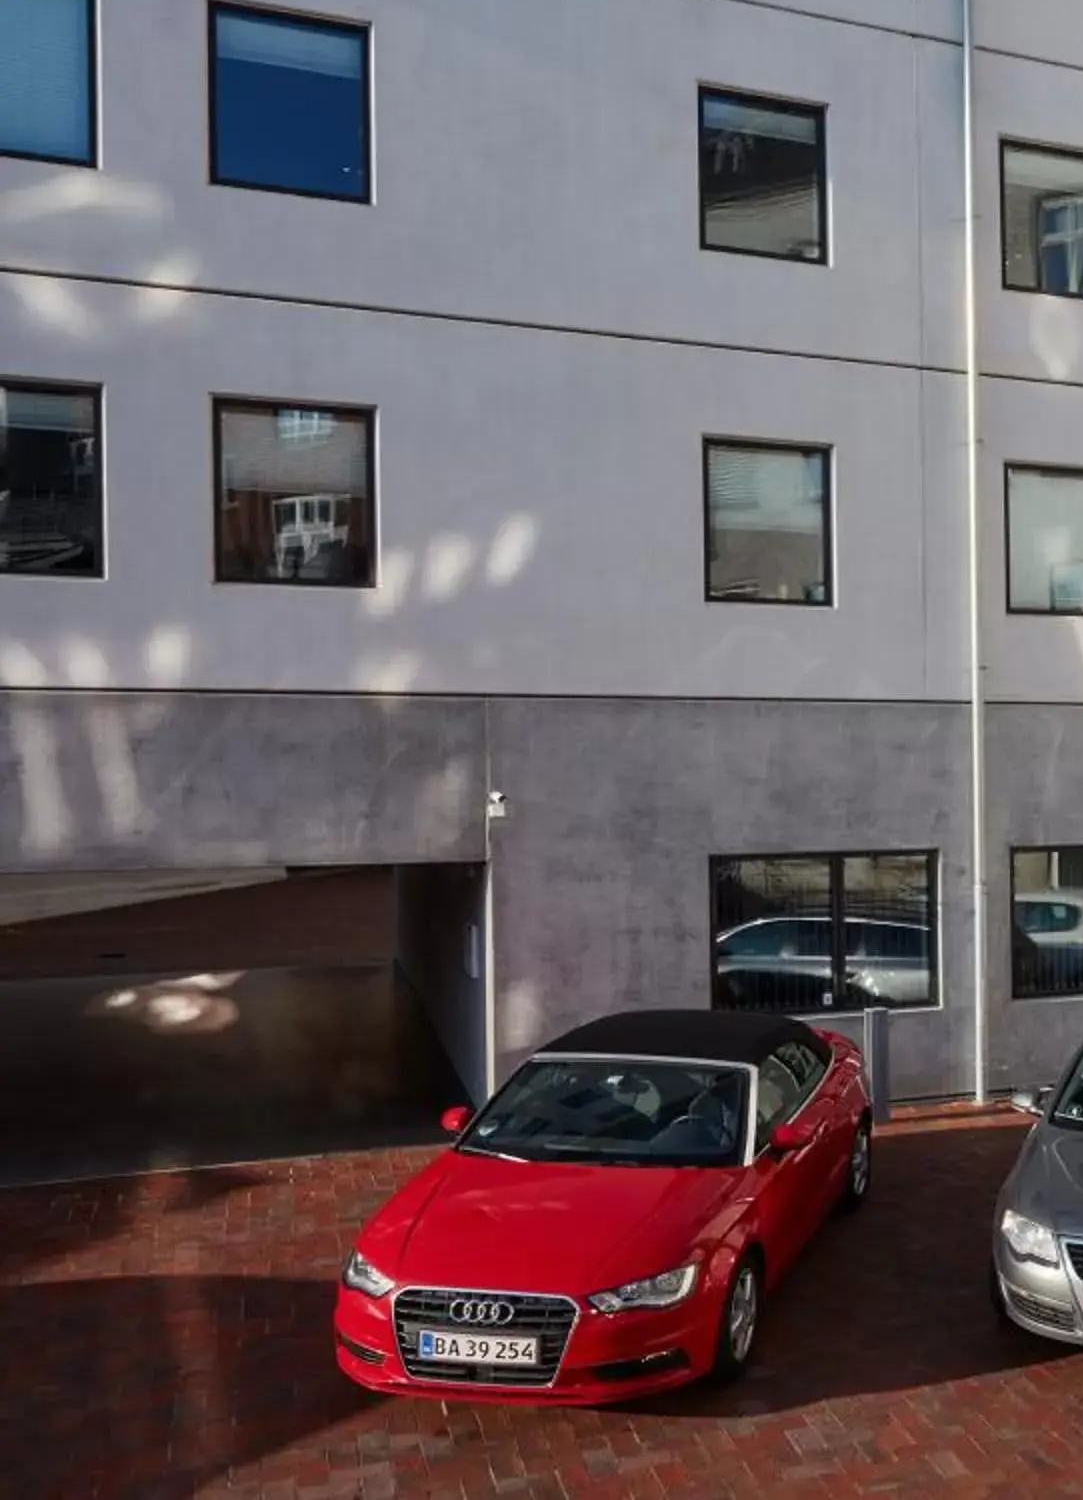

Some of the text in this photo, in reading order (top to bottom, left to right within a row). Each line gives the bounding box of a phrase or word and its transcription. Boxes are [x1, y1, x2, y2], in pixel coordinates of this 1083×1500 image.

[435, 1337, 533, 1360] BA 39 254
